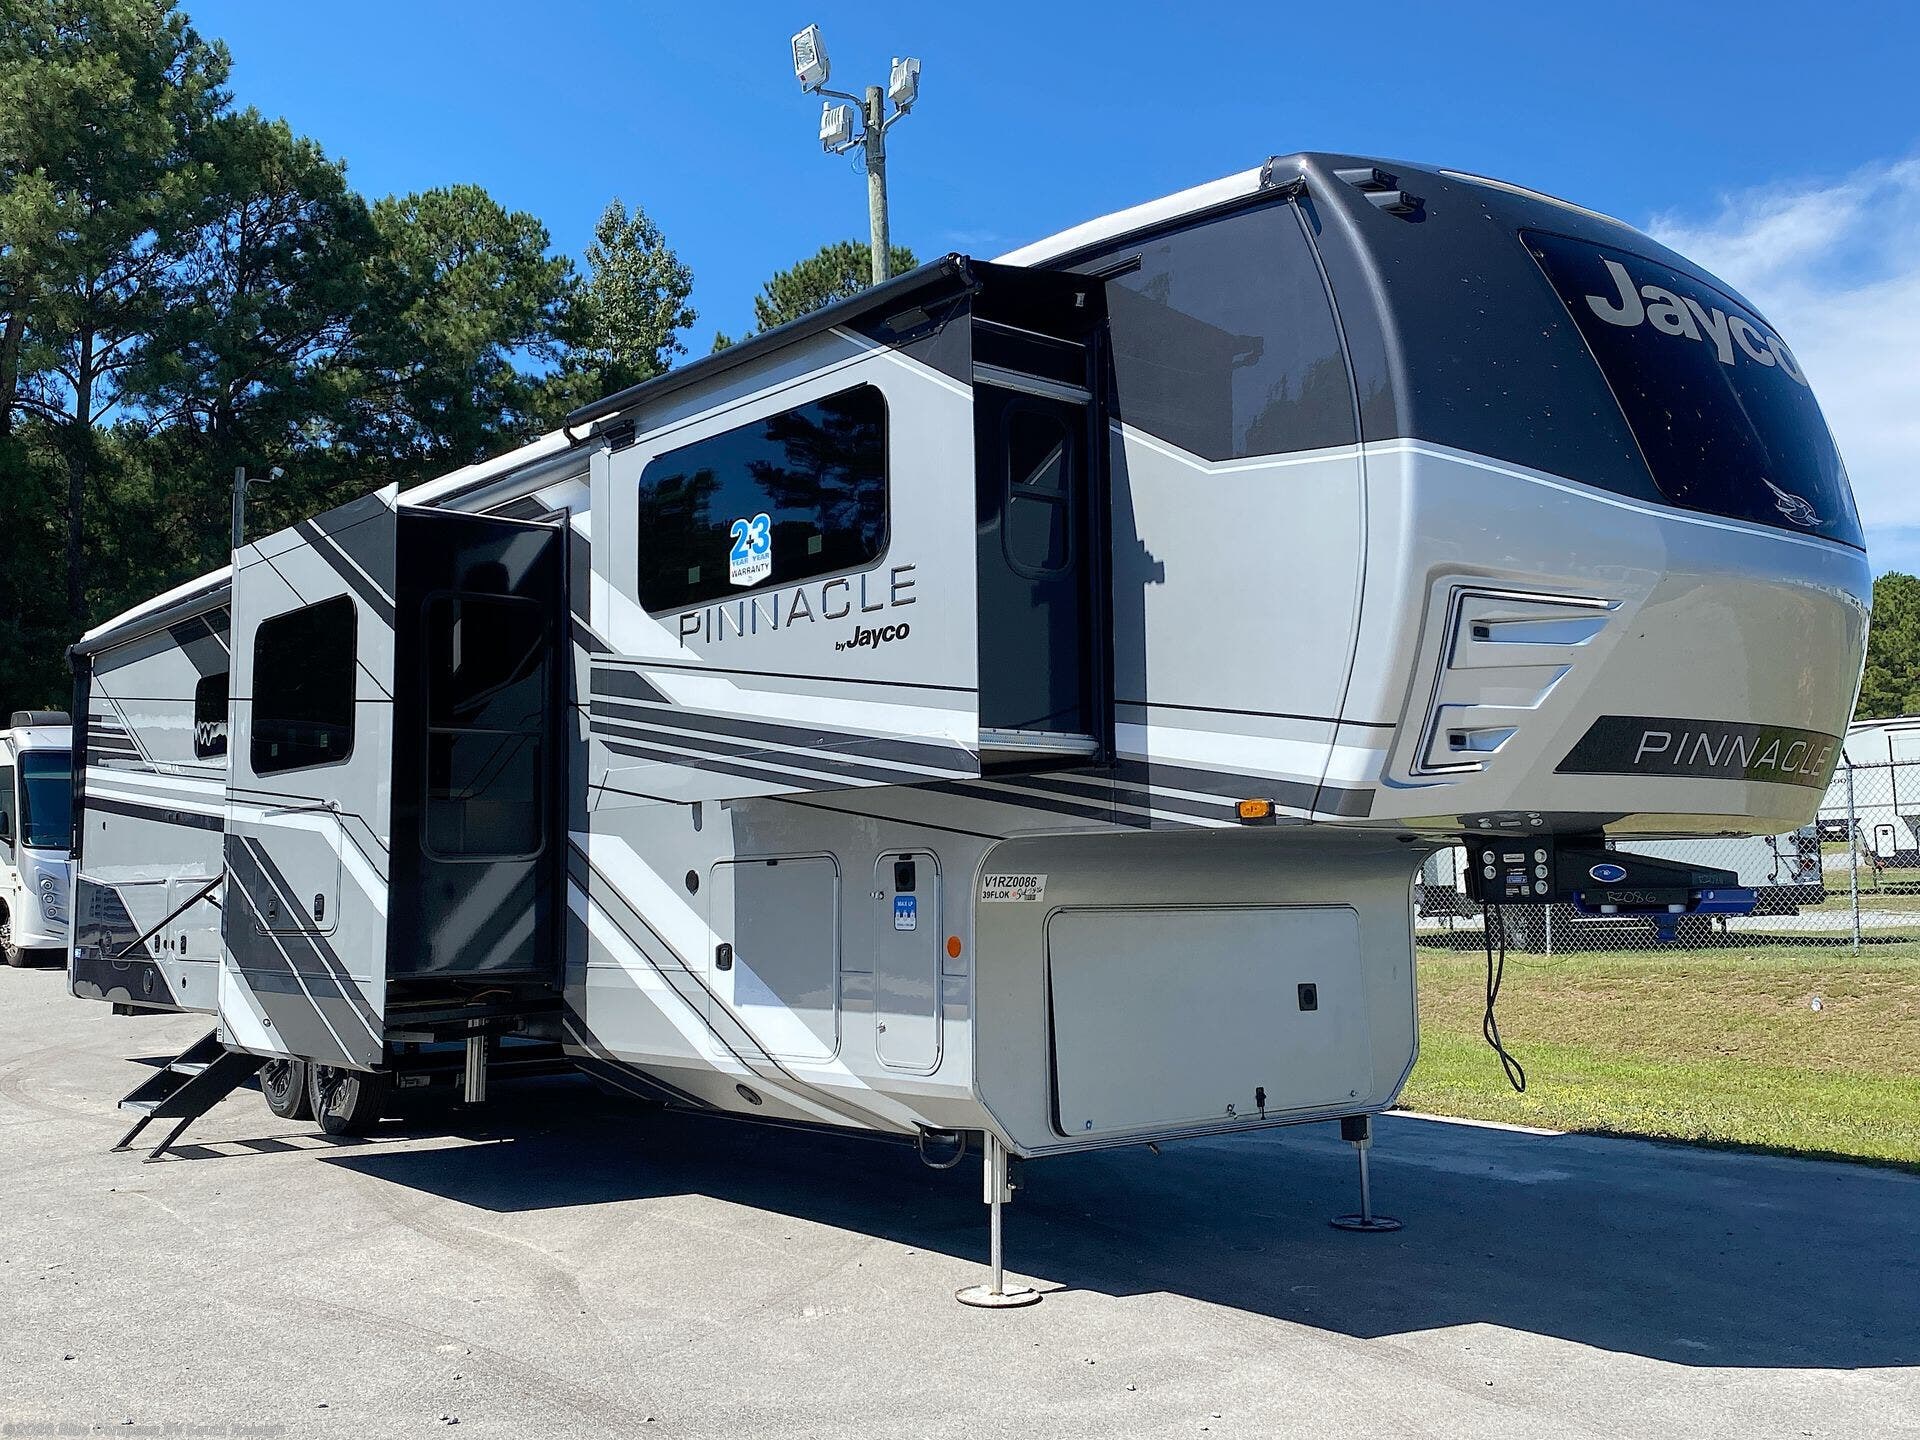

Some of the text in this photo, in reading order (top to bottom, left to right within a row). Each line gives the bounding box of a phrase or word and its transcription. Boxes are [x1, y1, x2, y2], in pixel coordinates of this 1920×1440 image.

[1584, 258, 1810, 387] Jayco
[731, 562, 770, 578] WARRANTY
[732, 552, 770, 567] YEAR YEAR
[679, 562, 917, 649] PINNACLE
[835, 621, 911, 652] by Jayco
[1633, 729, 1833, 778] PINNACLE
[984, 876, 1038, 888] V1RZ0086
